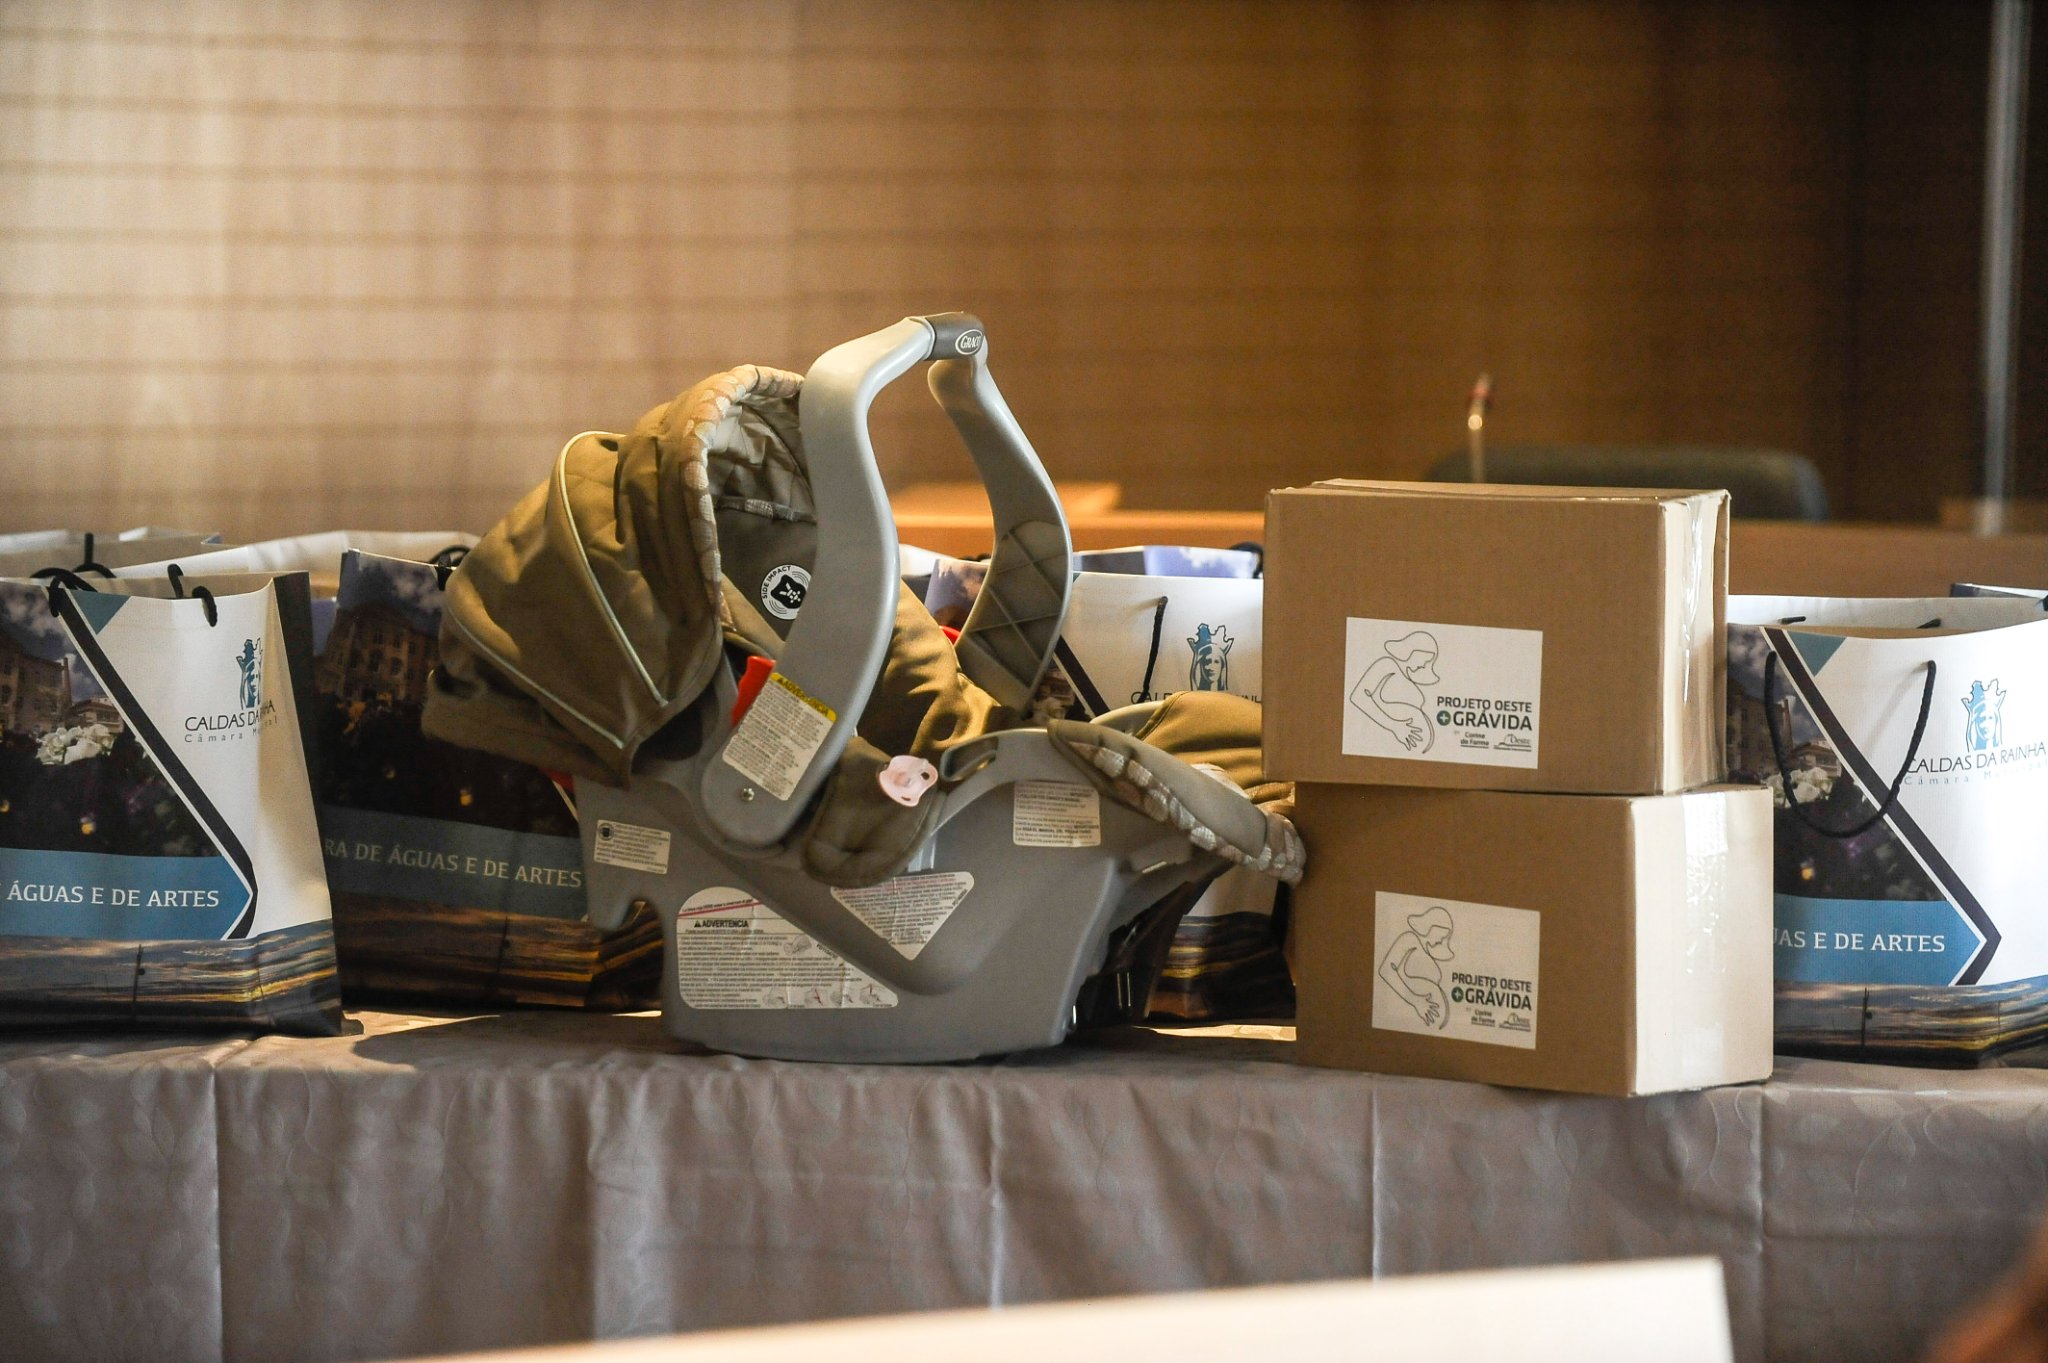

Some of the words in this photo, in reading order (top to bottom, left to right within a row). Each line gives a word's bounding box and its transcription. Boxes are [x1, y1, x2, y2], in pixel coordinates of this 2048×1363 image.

[762, 582, 770, 599] SIDE
[766, 565, 791, 582] IMPACT
[1437, 696, 1491, 710] PROJETO
[1495, 700, 1532, 713] OESTE
[185, 712, 245, 731] CALDAS
[1453, 709, 1532, 731] GRÁVIDA
[1976, 752, 1997, 769] DA
[2000, 741, 2047, 765] RAINHA
[354, 842, 384, 863] DE
[388, 841, 459, 872] ÁGUAS
[465, 857, 479, 875] E
[483, 859, 510, 879] DE
[514, 865, 583, 888] ARTES
[6, 880, 84, 903] ÁGUAS
[91, 887, 104, 905] E
[111, 888, 141, 907] DE
[146, 890, 220, 908] ARTES
[702, 919, 749, 928] ADVERTENCIA
[1813, 932, 1828, 949] E
[1834, 932, 1865, 950] DE
[1871, 934, 1946, 953] ARTES
[1451, 972, 1498, 988] PROJETO
[1500, 978, 1532, 993] OESTE
[1465, 986, 1532, 1011] GRÁVIDA
